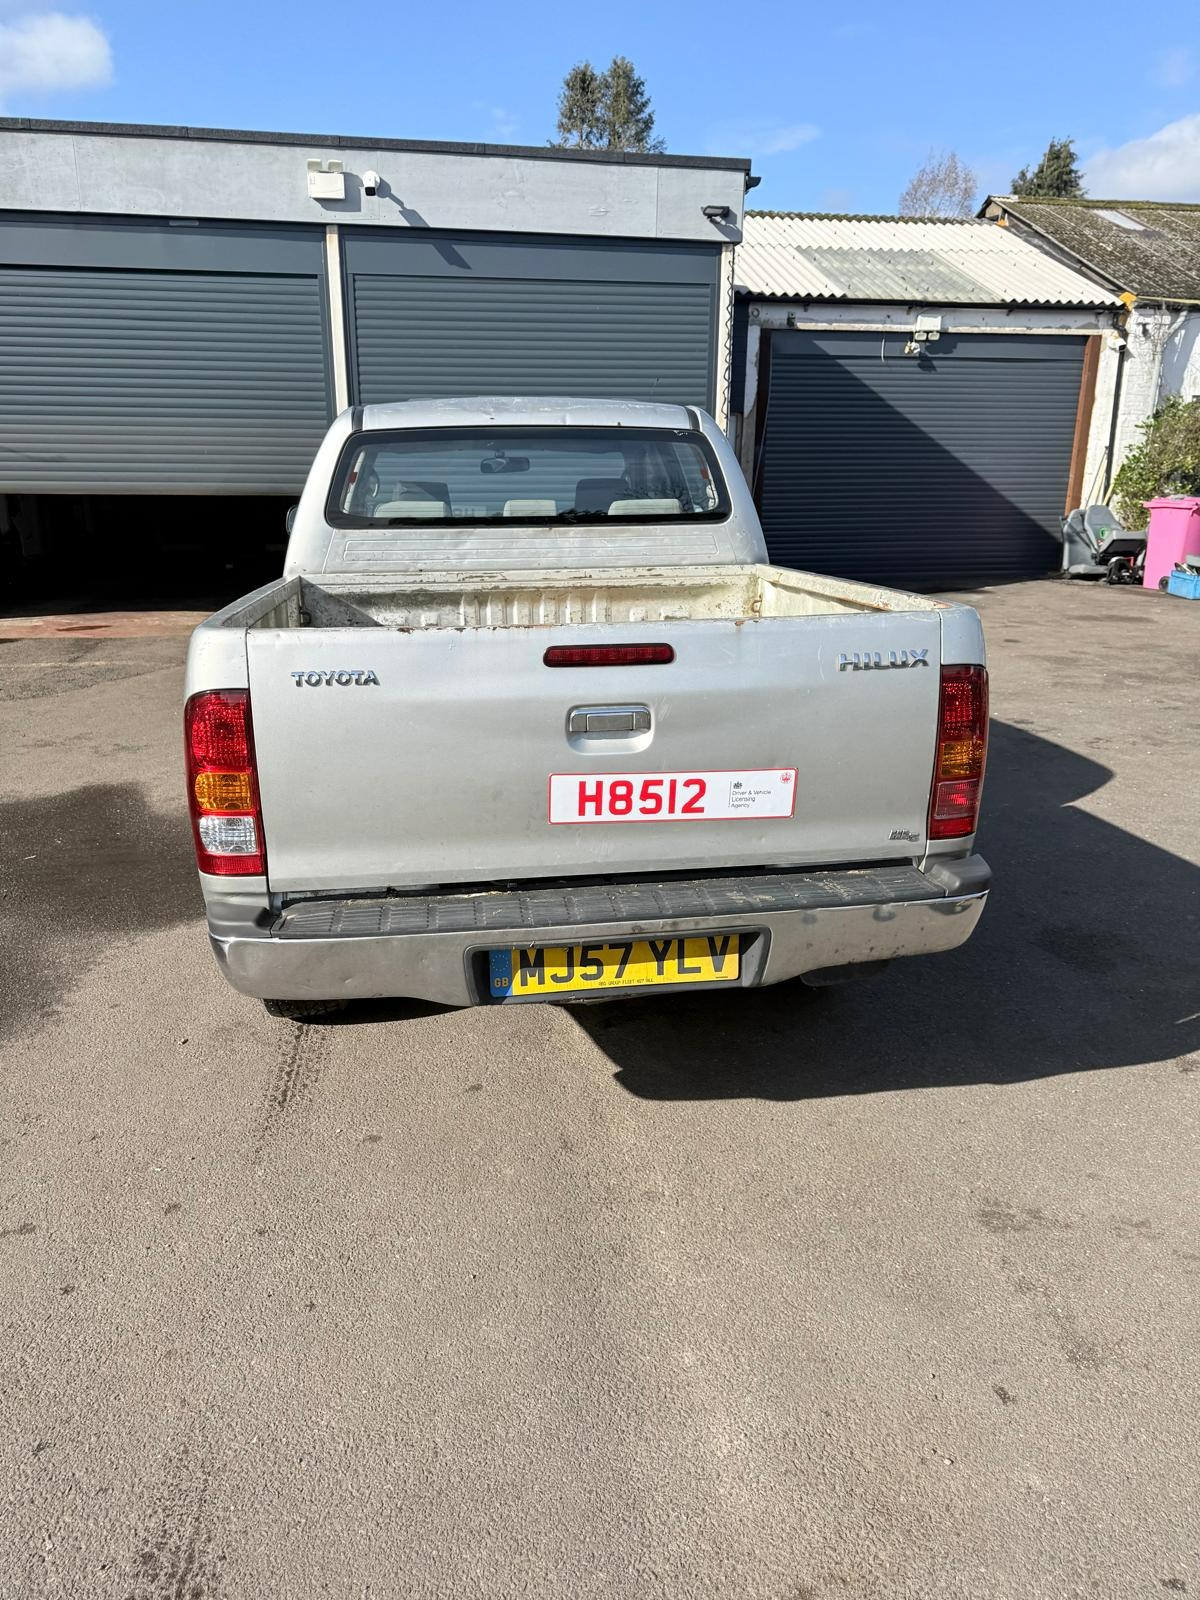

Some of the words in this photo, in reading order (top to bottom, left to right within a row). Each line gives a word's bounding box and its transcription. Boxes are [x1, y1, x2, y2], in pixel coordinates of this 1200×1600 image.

[838, 648, 929, 671] HILUX
[290, 670, 380, 687] TOYOTA
[578, 778, 707, 816] H8512
[519, 942, 634, 987] MJ57
[648, 935, 731, 976] YLV
[494, 977, 509, 988] GB
